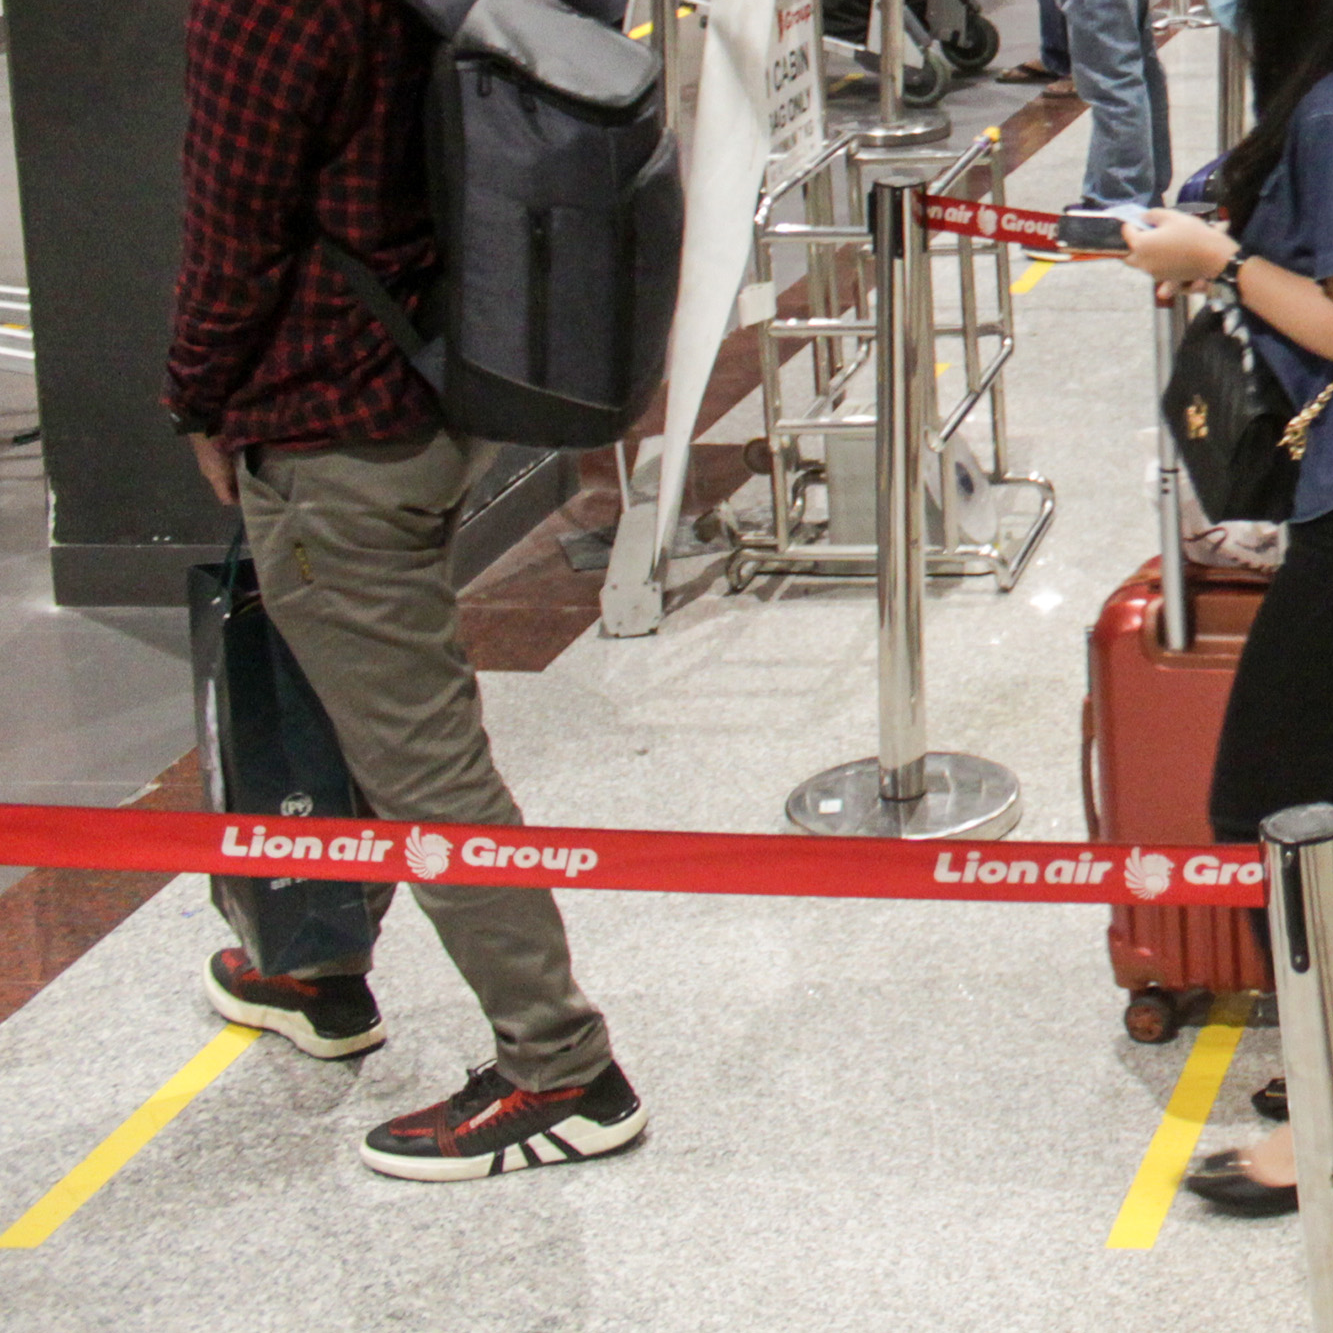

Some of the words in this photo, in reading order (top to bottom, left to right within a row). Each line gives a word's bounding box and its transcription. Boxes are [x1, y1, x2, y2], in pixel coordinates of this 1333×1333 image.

[773, 42, 810, 92] CABIN
[788, 83, 811, 124] ONLY
[944, 204, 973, 224] air
[221, 825, 323, 860] Lion
[328, 829, 394, 862] air
[461, 837, 598, 877] Group
[934, 851, 1039, 883] Lion
[1045, 852, 1113, 884] air
